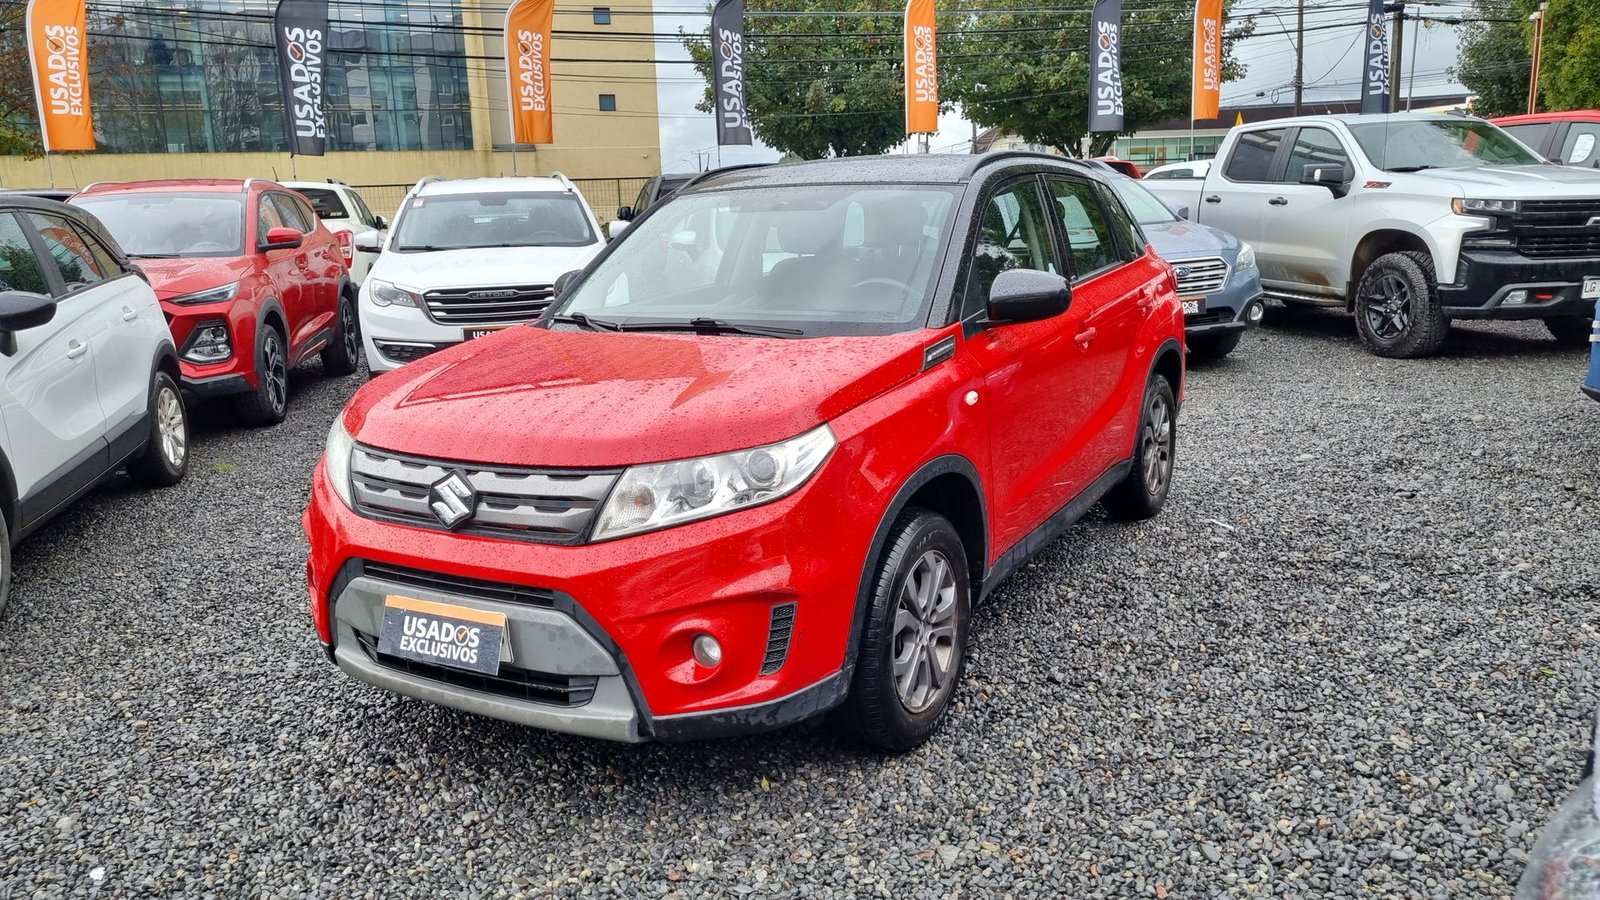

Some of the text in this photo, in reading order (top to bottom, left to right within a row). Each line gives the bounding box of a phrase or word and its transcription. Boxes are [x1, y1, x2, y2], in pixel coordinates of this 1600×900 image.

[44, 25, 70, 115] USADOS
[65, 26, 83, 116] EXCLUSIVOS
[284, 27, 316, 137] USADOS
[517, 29, 534, 111] USADOS
[532, 32, 546, 112] EXCLUSIVOS
[719, 28, 741, 128] USADOS
[913, 25, 928, 102] USADOS
[924, 27, 936, 102] EXCLUSIVOS
[1097, 21, 1115, 115] USADOS
[1203, 18, 1214, 90] USADOS
[1369, 13, 1384, 95] USADOS
[399, 635, 478, 664] EXCLUSIVOS
[402, 615, 481, 648] USADOS
